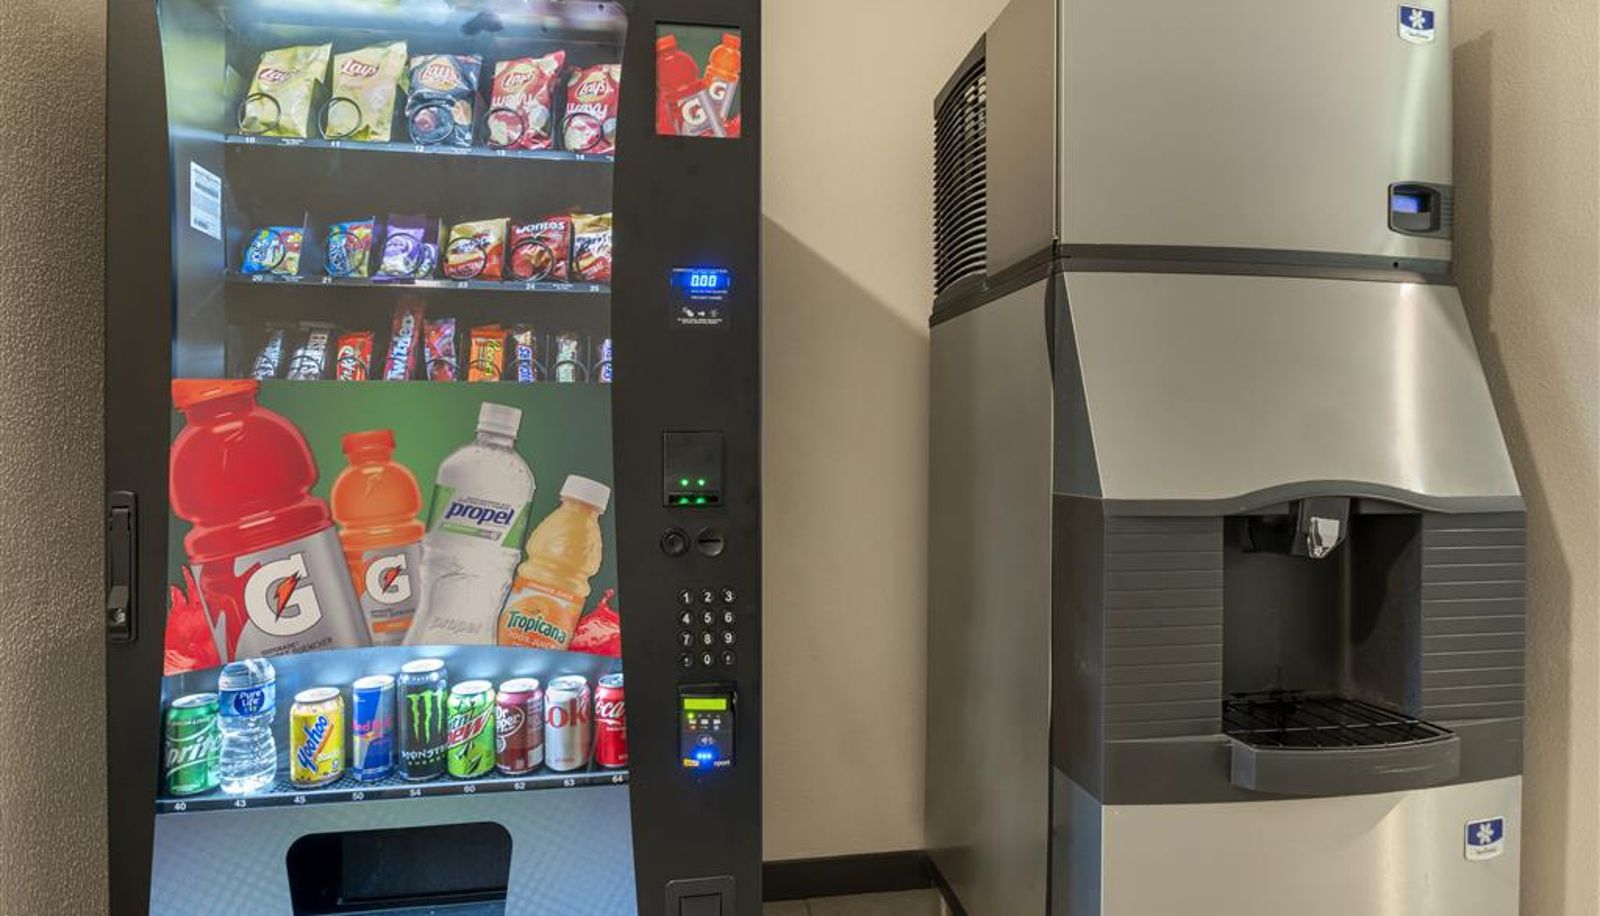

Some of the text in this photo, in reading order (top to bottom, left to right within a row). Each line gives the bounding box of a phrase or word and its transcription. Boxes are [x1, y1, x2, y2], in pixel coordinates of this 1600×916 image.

[709, 81, 728, 100] G
[682, 98, 708, 125] G
[444, 502, 515, 525] propel
[365, 554, 411, 604] G
[244, 553, 323, 636] G
[704, 592, 712, 603] 2
[725, 590, 732, 602] 3
[682, 613, 690, 624] 4
[724, 612, 732, 623] 6
[507, 611, 567, 643] Tropicana
[704, 633, 712, 645] 8
[724, 632, 732, 643] 9
[704, 654, 711, 665] 0
[514, 782, 525, 790] 62
[564, 779, 575, 787] 63
[410, 789, 421, 797] 54
[464, 785, 476, 793] 60
[294, 795, 306, 804] 45
[352, 792, 364, 800] 50
[175, 802, 187, 811] 40
[234, 800, 246, 808] 43
